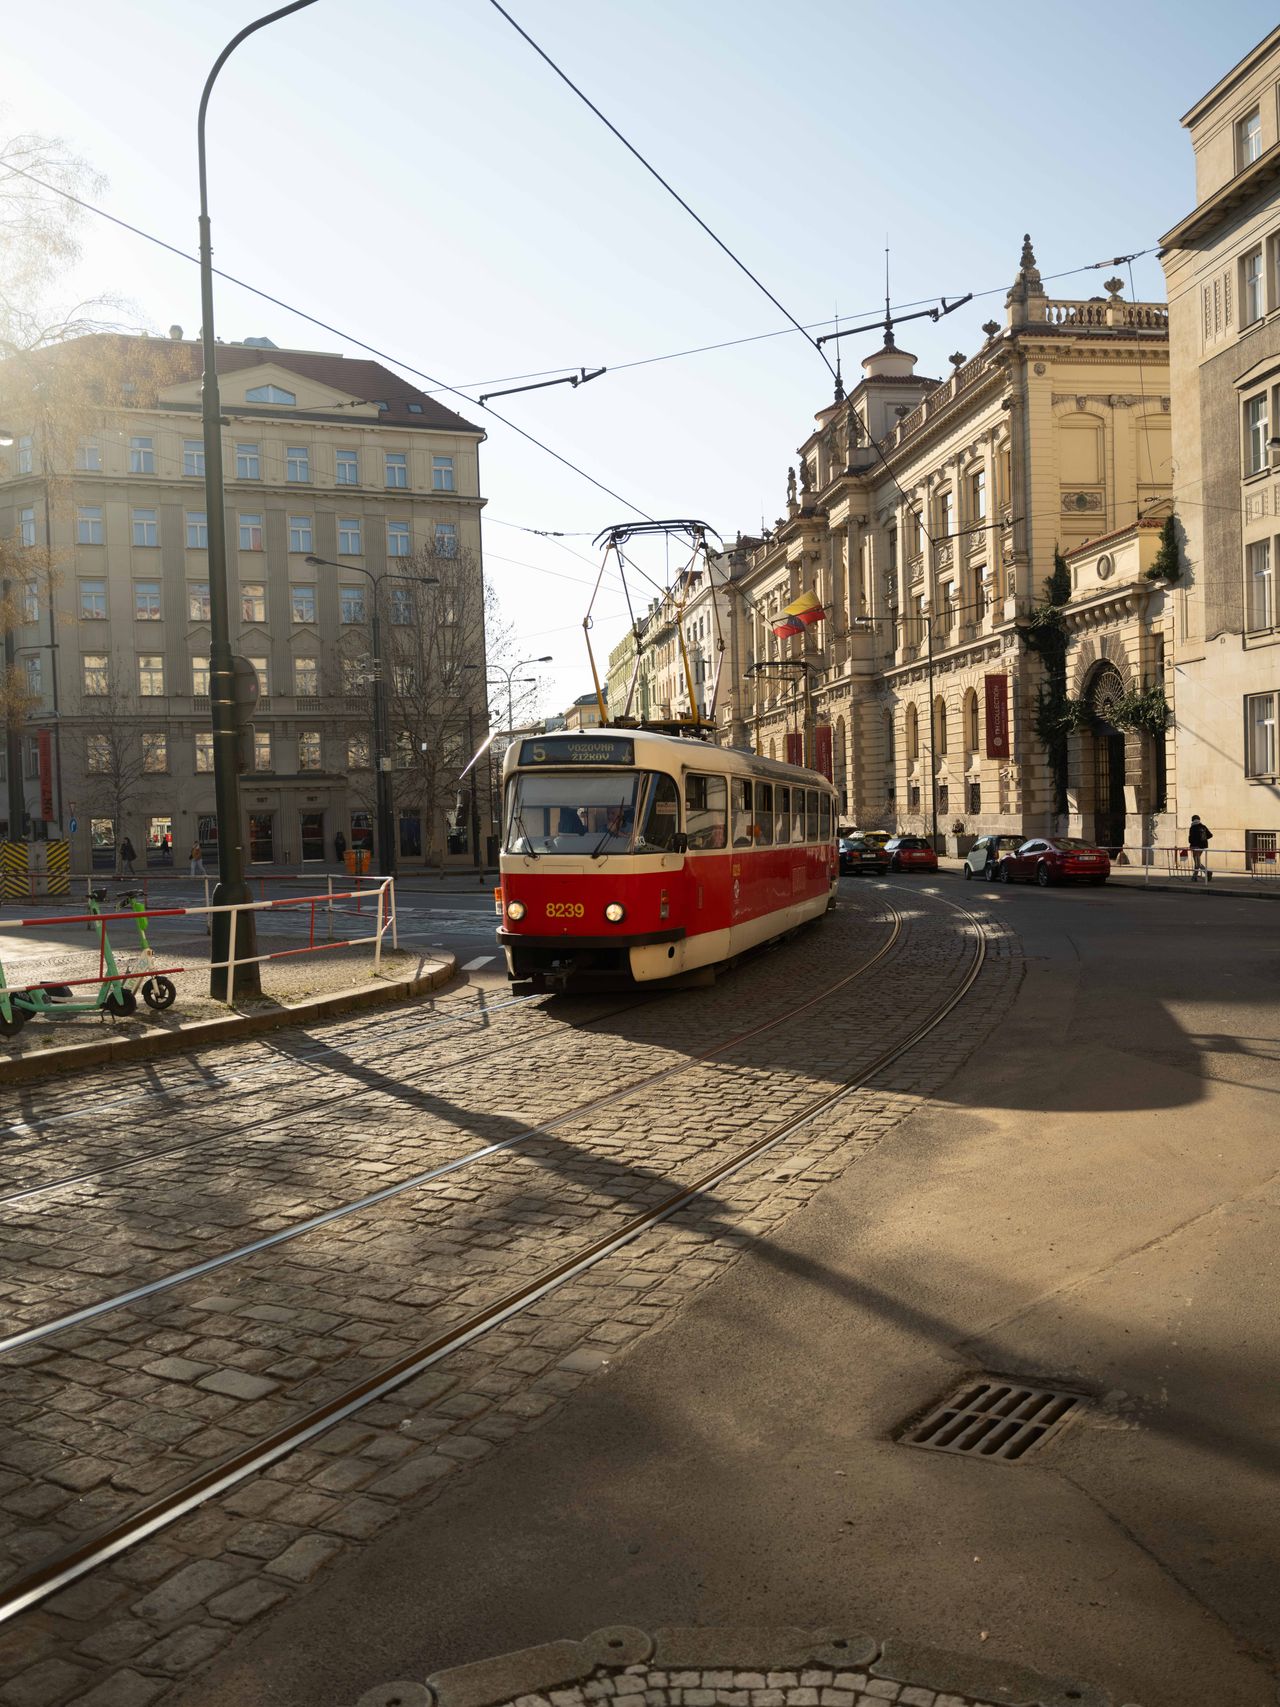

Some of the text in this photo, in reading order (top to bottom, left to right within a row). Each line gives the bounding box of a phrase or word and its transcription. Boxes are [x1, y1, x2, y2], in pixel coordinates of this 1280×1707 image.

[533, 744, 546, 761] 5
[568, 743, 614, 752] VOZOVNA
[571, 751, 610, 761] ŽIŽKOV
[546, 903, 585, 918] 8239
